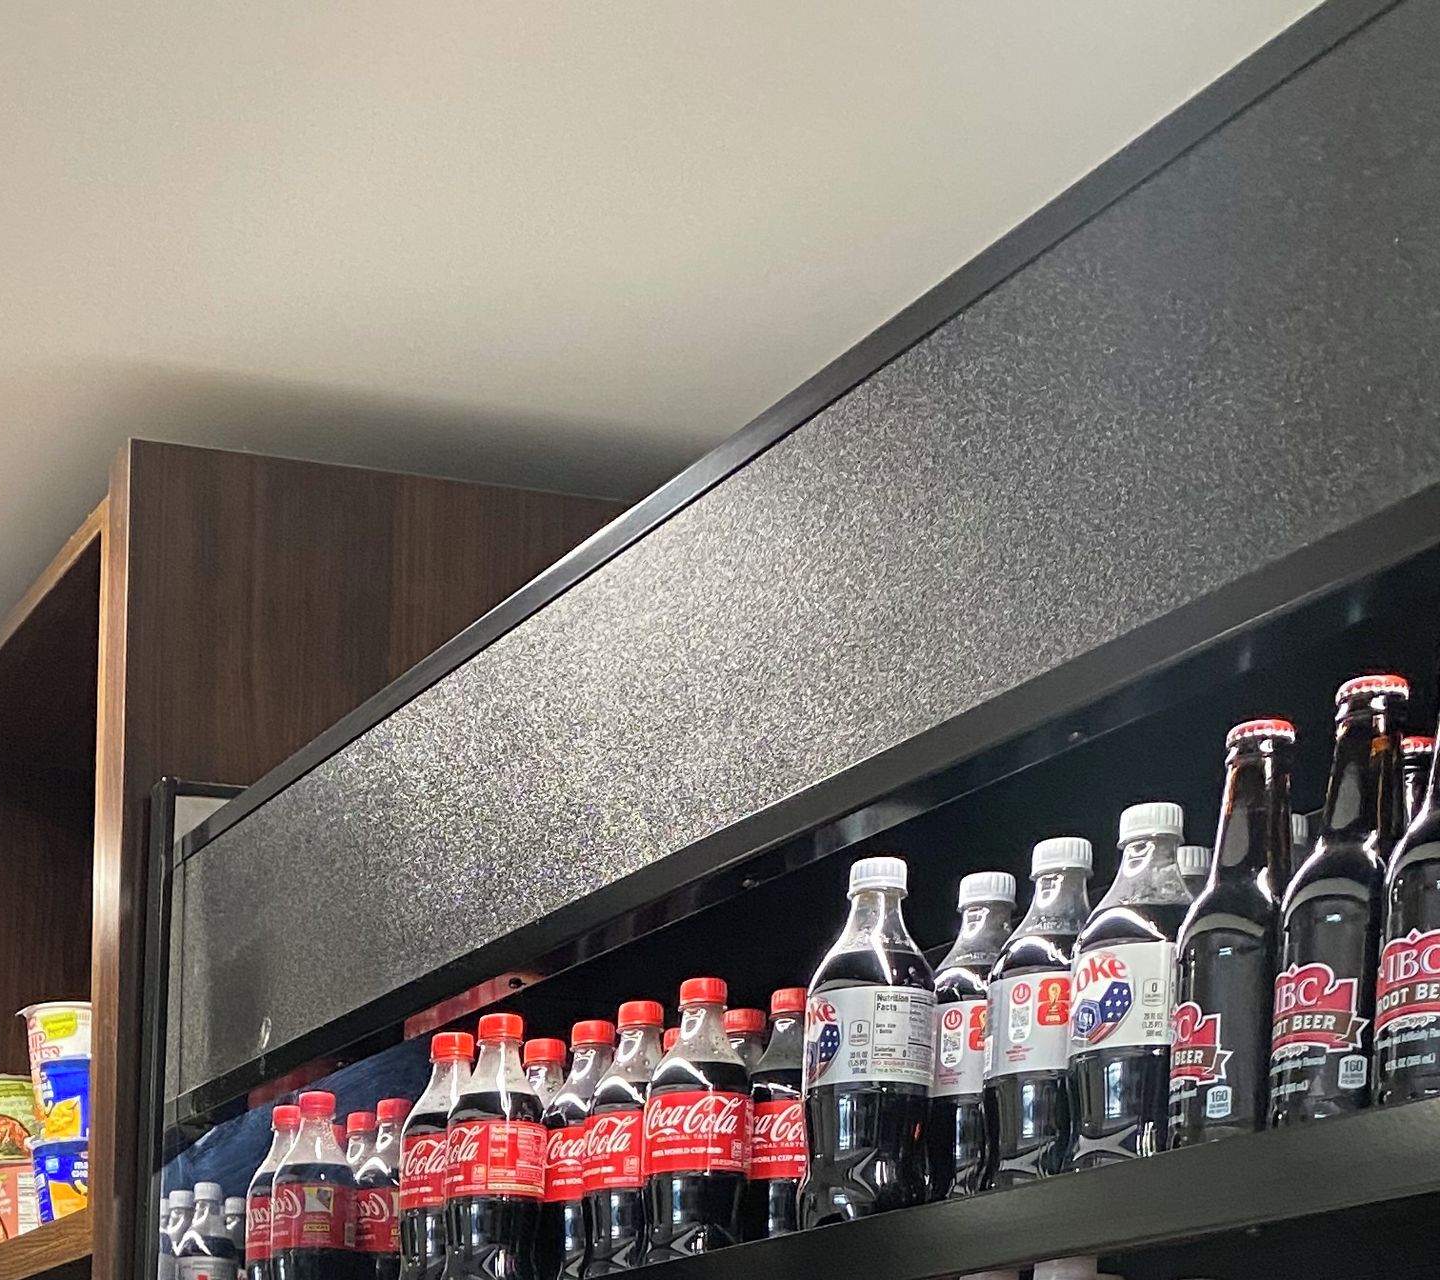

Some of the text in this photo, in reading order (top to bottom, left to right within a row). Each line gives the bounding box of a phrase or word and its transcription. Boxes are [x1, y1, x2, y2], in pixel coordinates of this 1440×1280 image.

[1077, 957, 1128, 992] oke
[877, 994, 909, 1003] Nutrition
[1275, 977, 1319, 1014] IBC
[1415, 983, 1440, 1000] BE
[876, 1003, 897, 1012] Facts
[856, 1023, 863, 1033] 0
[1292, 1015, 1336, 1031] BEER
[1174, 1050, 1204, 1066] BEER
[1344, 1060, 1363, 1072] 160
[1211, 1090, 1228, 1102] 160
[646, 1095, 743, 1139] Coca-Cola
